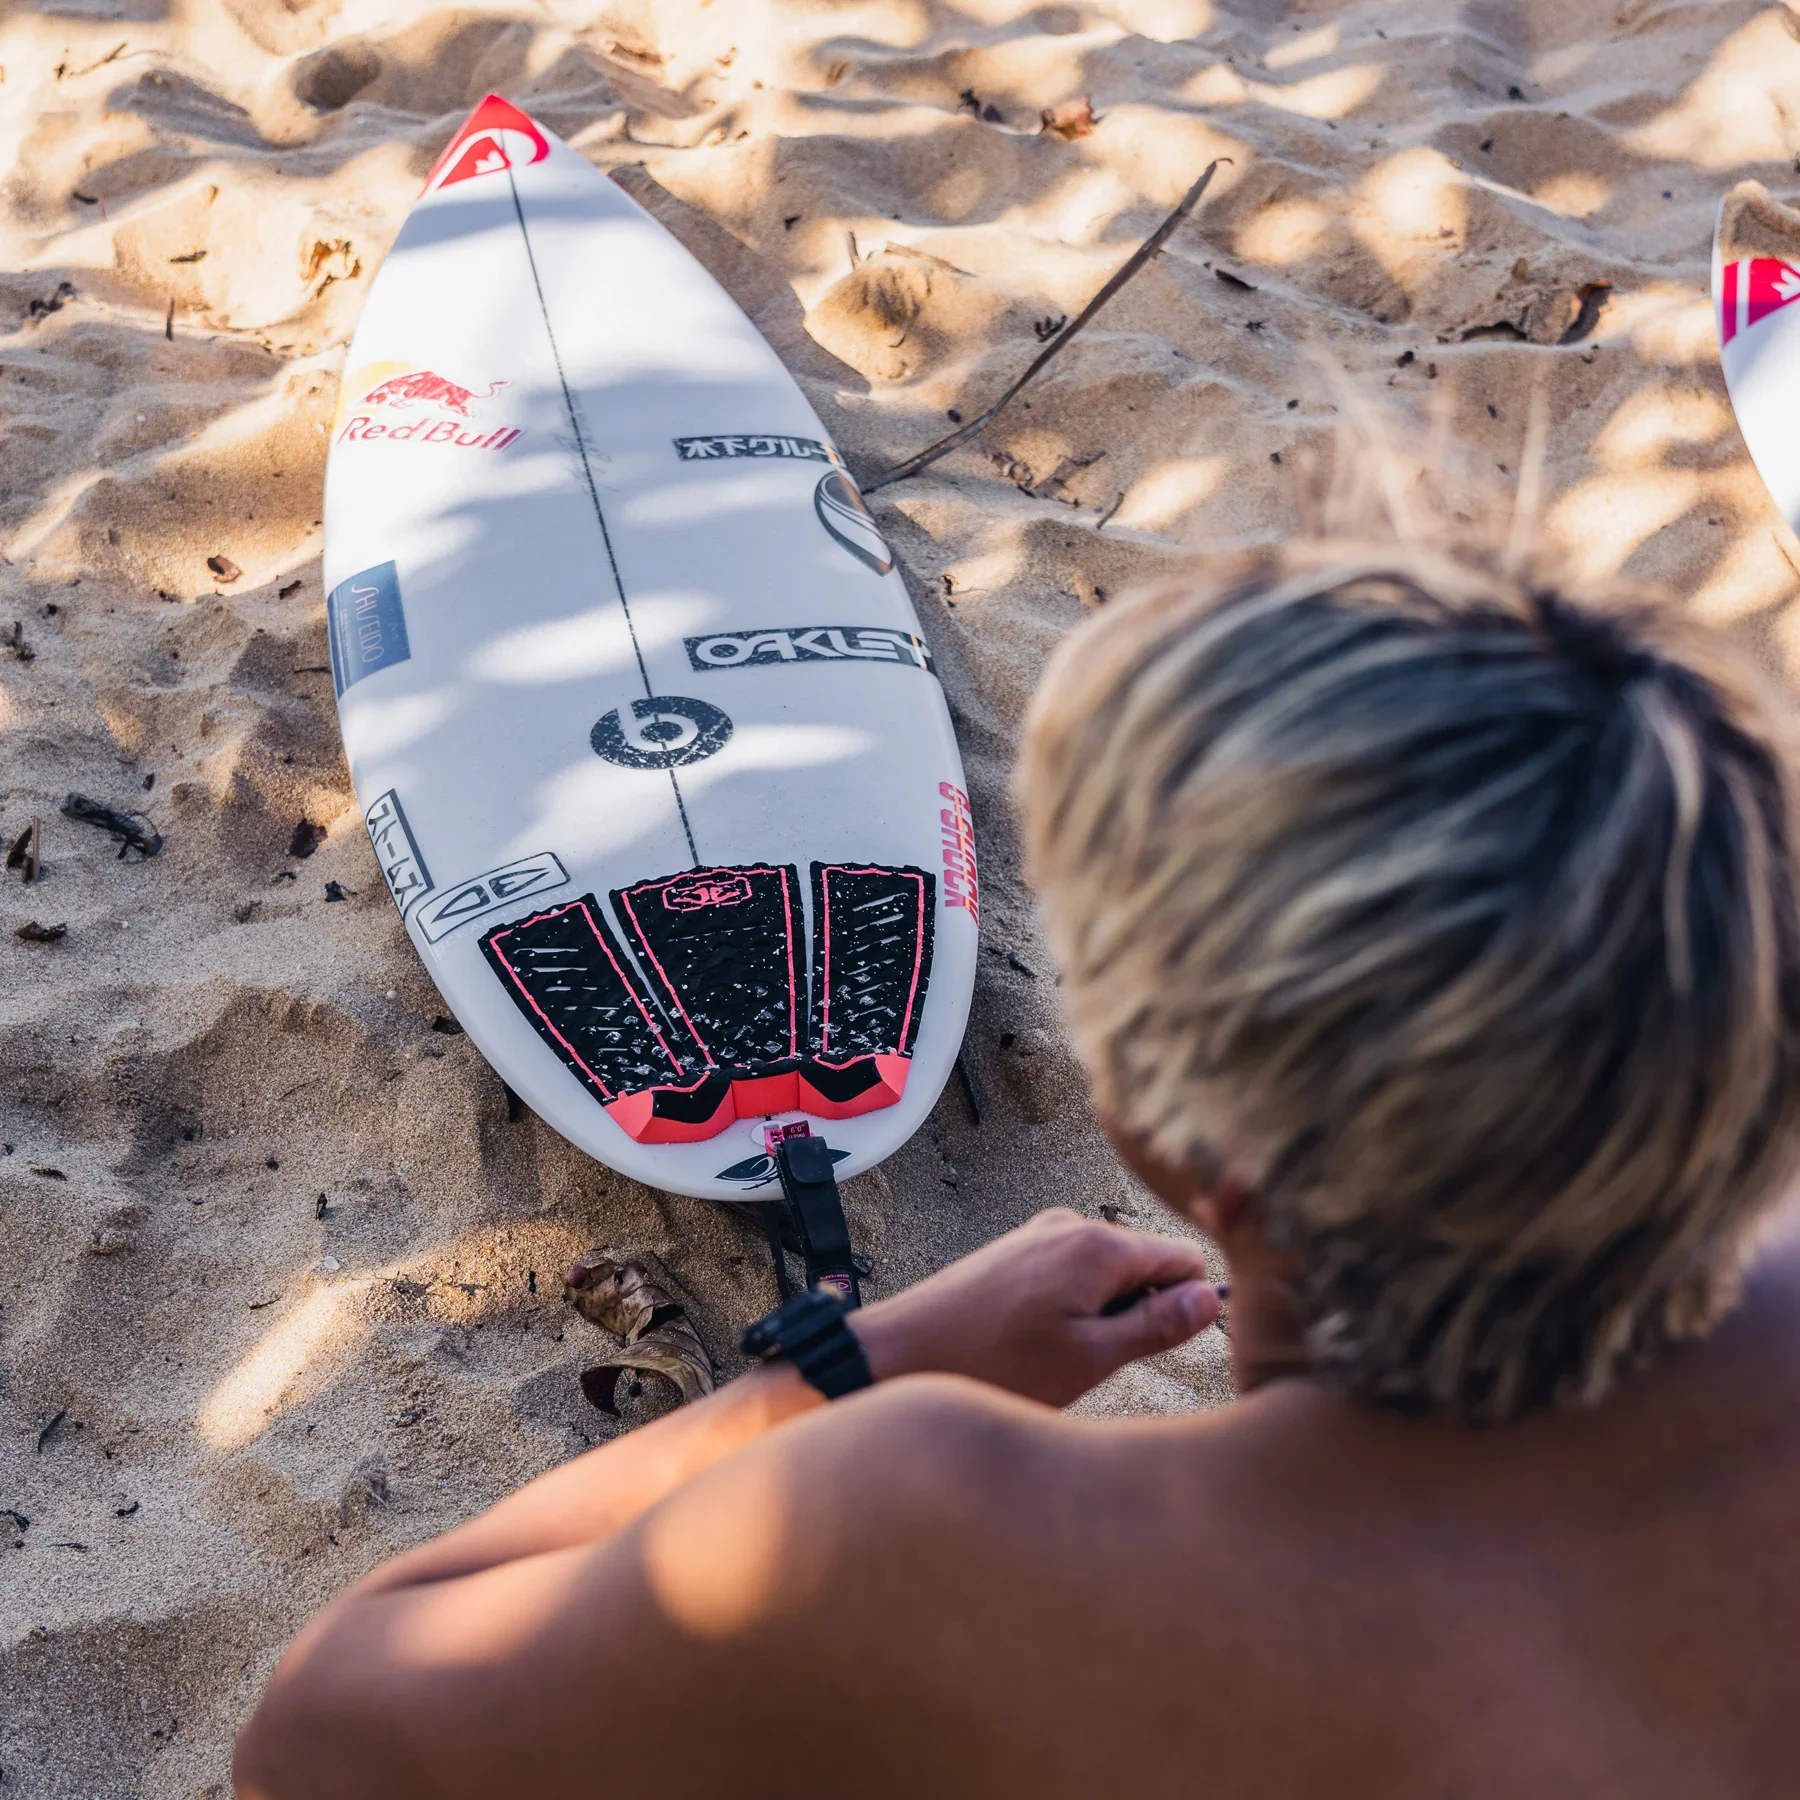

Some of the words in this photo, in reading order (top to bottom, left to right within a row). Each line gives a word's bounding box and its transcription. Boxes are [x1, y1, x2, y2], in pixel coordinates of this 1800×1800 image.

[337, 416, 430, 446] Red
[421, 421, 523, 451] Bull
[351, 583, 385, 663] SHISEIDO
[695, 630, 932, 670] OAKLEY
[368, 802, 425, 907] ストームズ
[938, 781, 979, 927] G-SHOCK
[512, 884, 580, 915] EARTH
